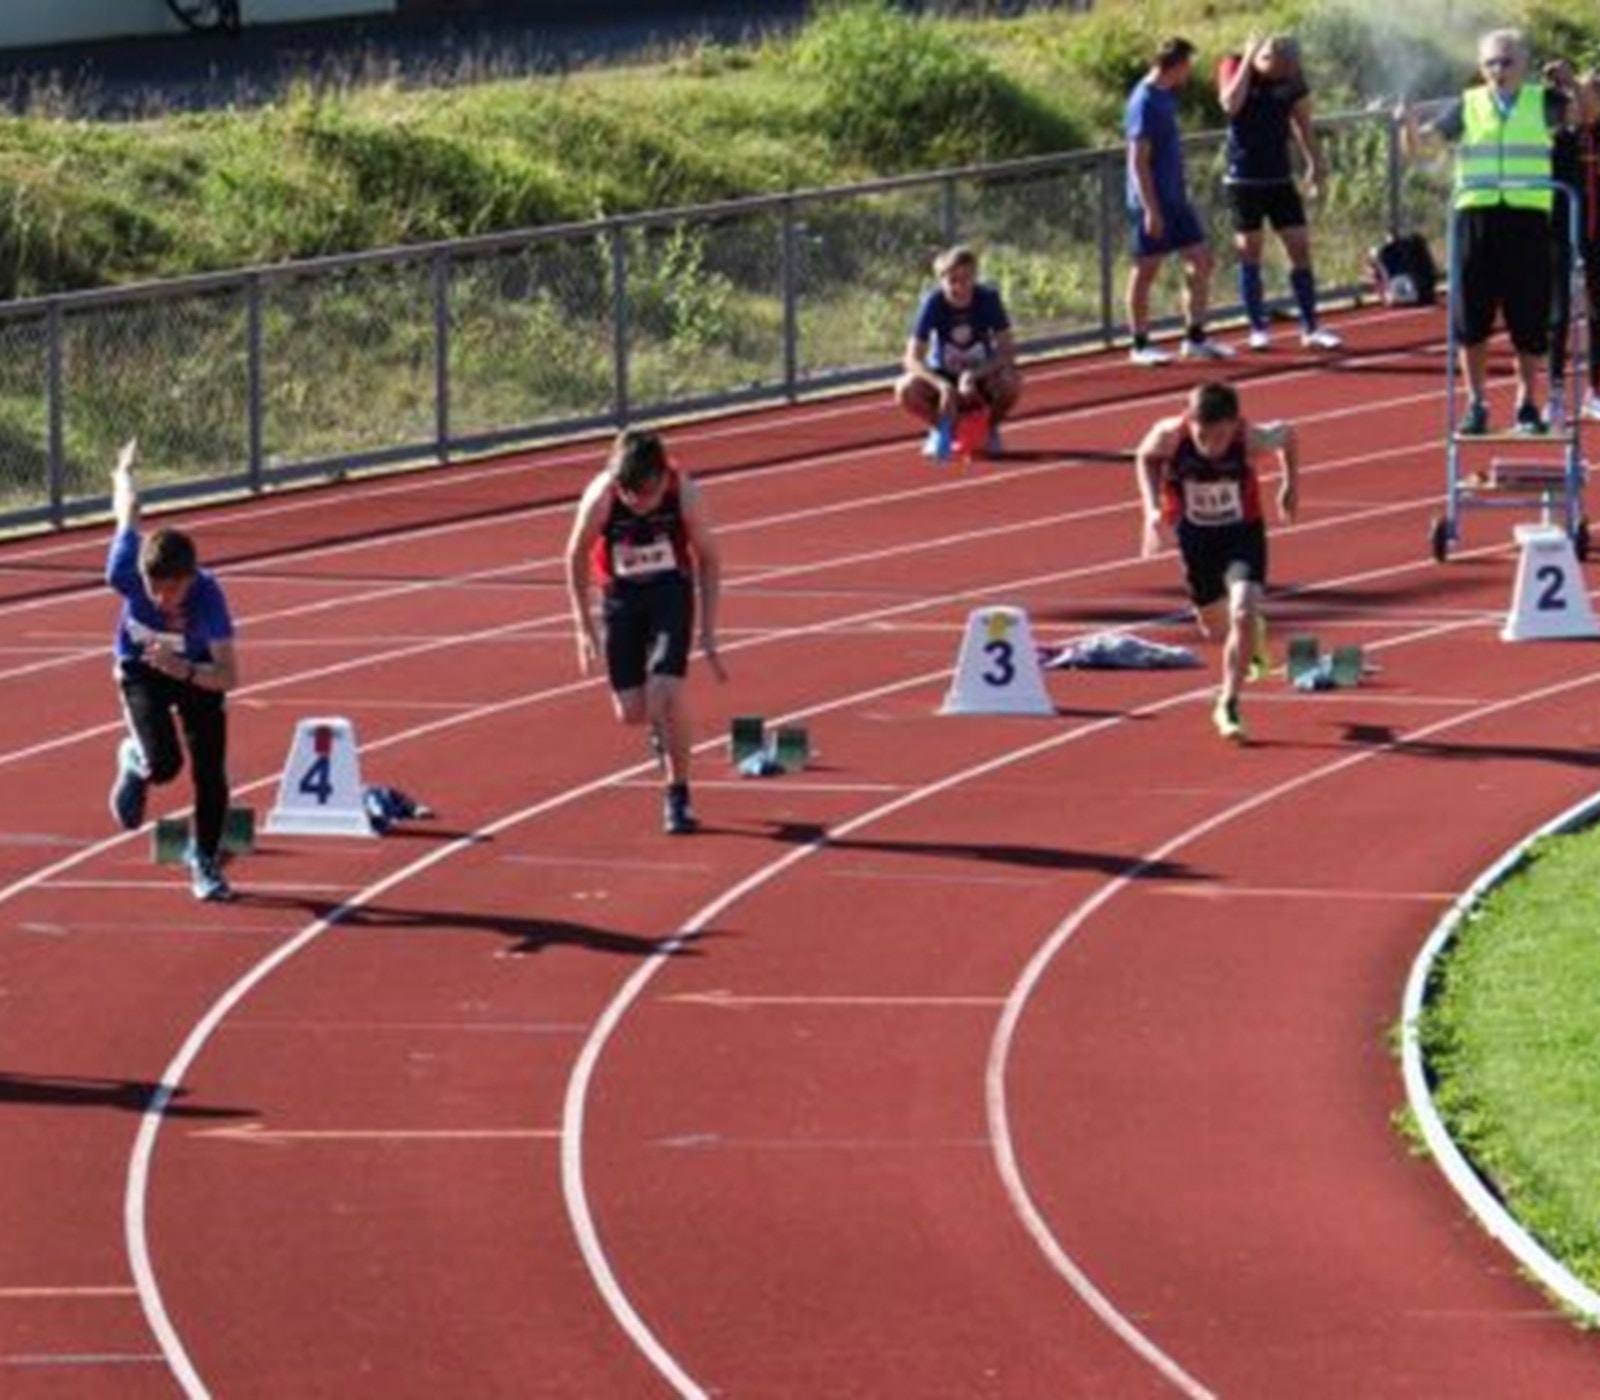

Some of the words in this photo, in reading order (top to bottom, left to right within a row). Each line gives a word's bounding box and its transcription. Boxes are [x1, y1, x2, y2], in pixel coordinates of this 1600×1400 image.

[1537, 566, 1566, 611] 2
[982, 641, 1014, 687] 3
[299, 757, 333, 805] 4
